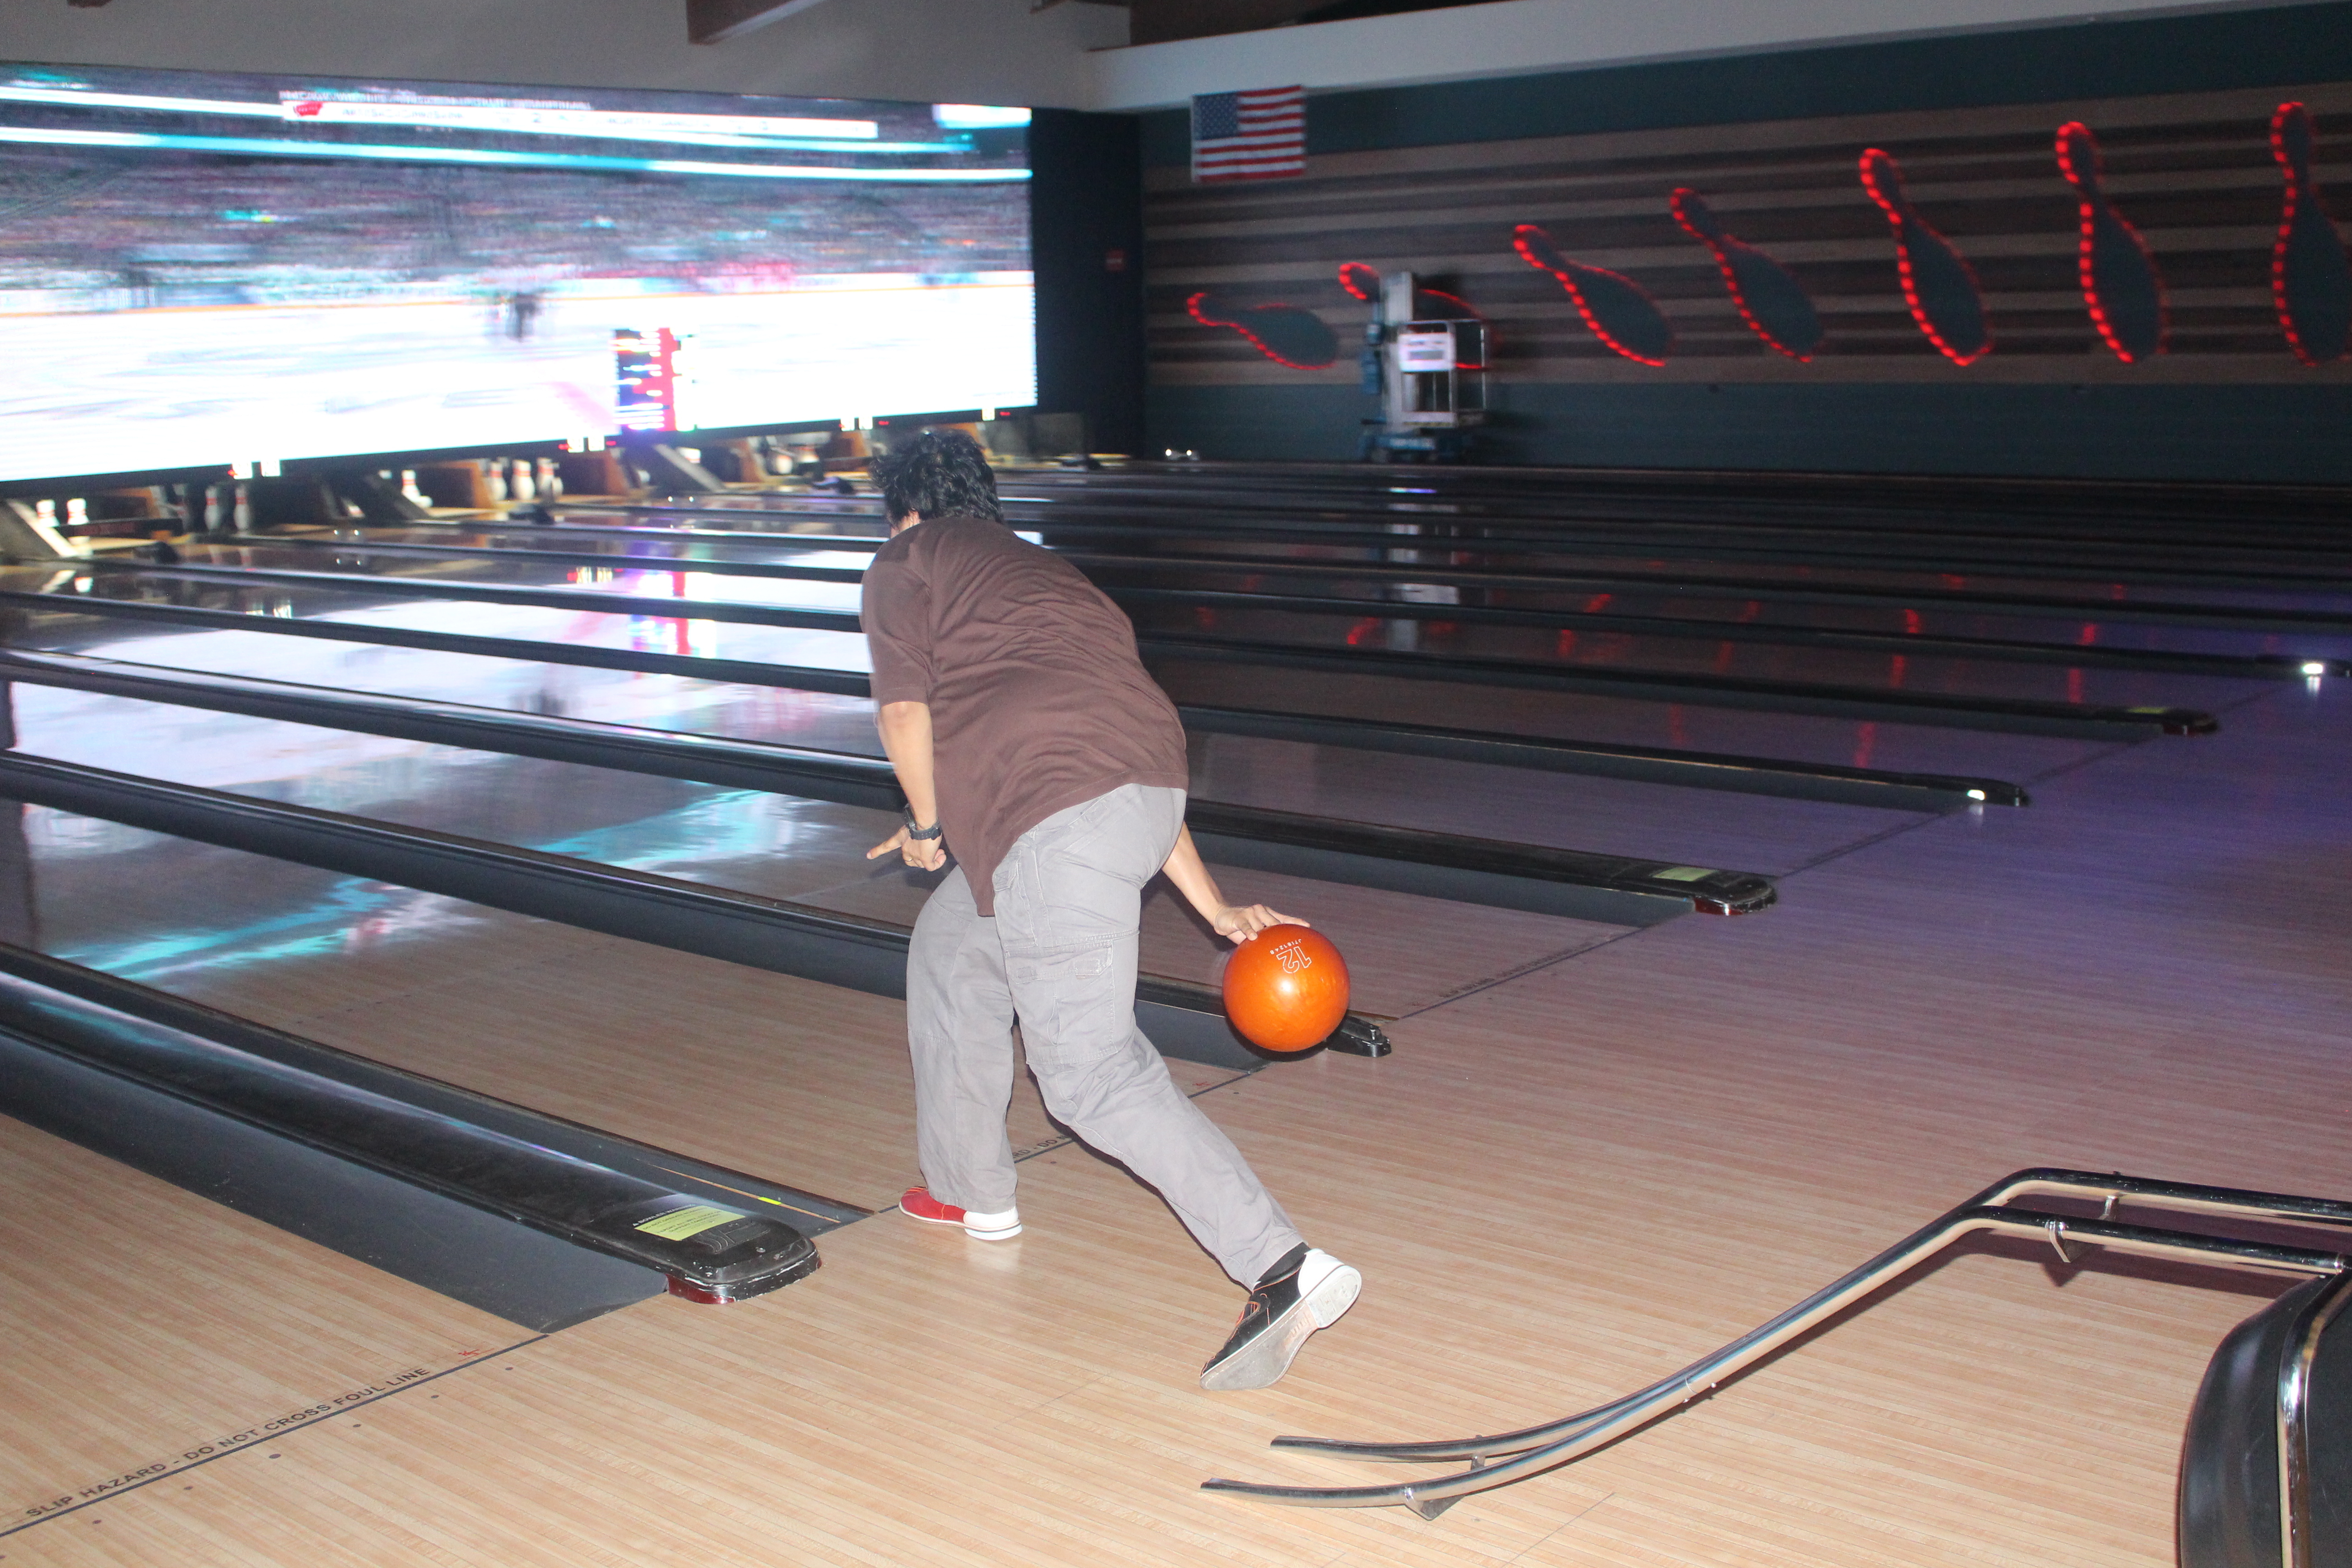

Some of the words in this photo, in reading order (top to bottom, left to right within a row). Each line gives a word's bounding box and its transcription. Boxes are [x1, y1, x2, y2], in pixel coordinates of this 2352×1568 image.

[1276, 946, 1312, 973] 12
[26, 1496, 73, 1516] SLIP
[79, 1463, 167, 1497] HAZARD
[183, 1446, 215, 1460] DO
[218, 1429, 260, 1447] NOT
[264, 1404, 332, 1431] CROSS
[333, 1387, 386, 1406] FOUL
[386, 1368, 431, 1386] LINE
